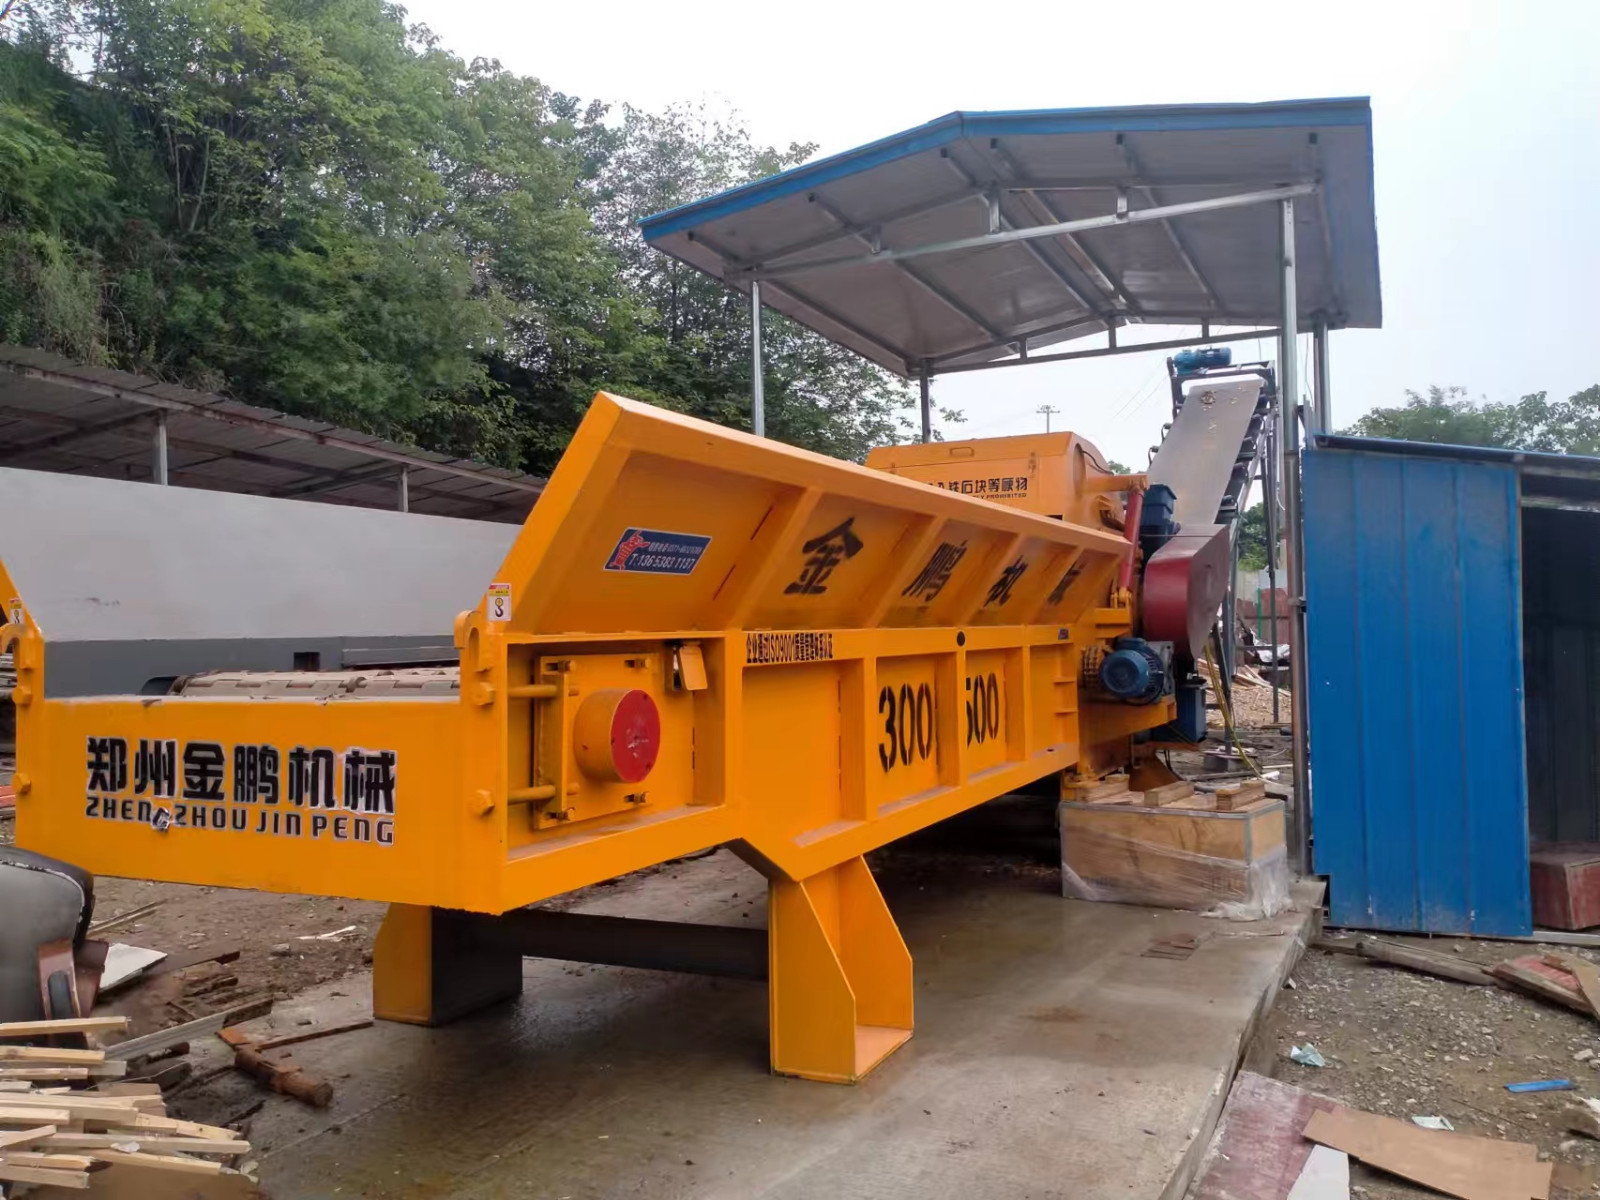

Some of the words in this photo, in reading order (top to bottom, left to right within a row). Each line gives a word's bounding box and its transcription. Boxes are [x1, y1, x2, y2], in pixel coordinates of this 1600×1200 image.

[879, 684, 932, 774] 300
[87, 737, 395, 814] 郑州金鹏机械
[174, 804, 246, 831] ZHOU
[256, 811, 301, 836] JIN
[312, 815, 394, 844] PENG
